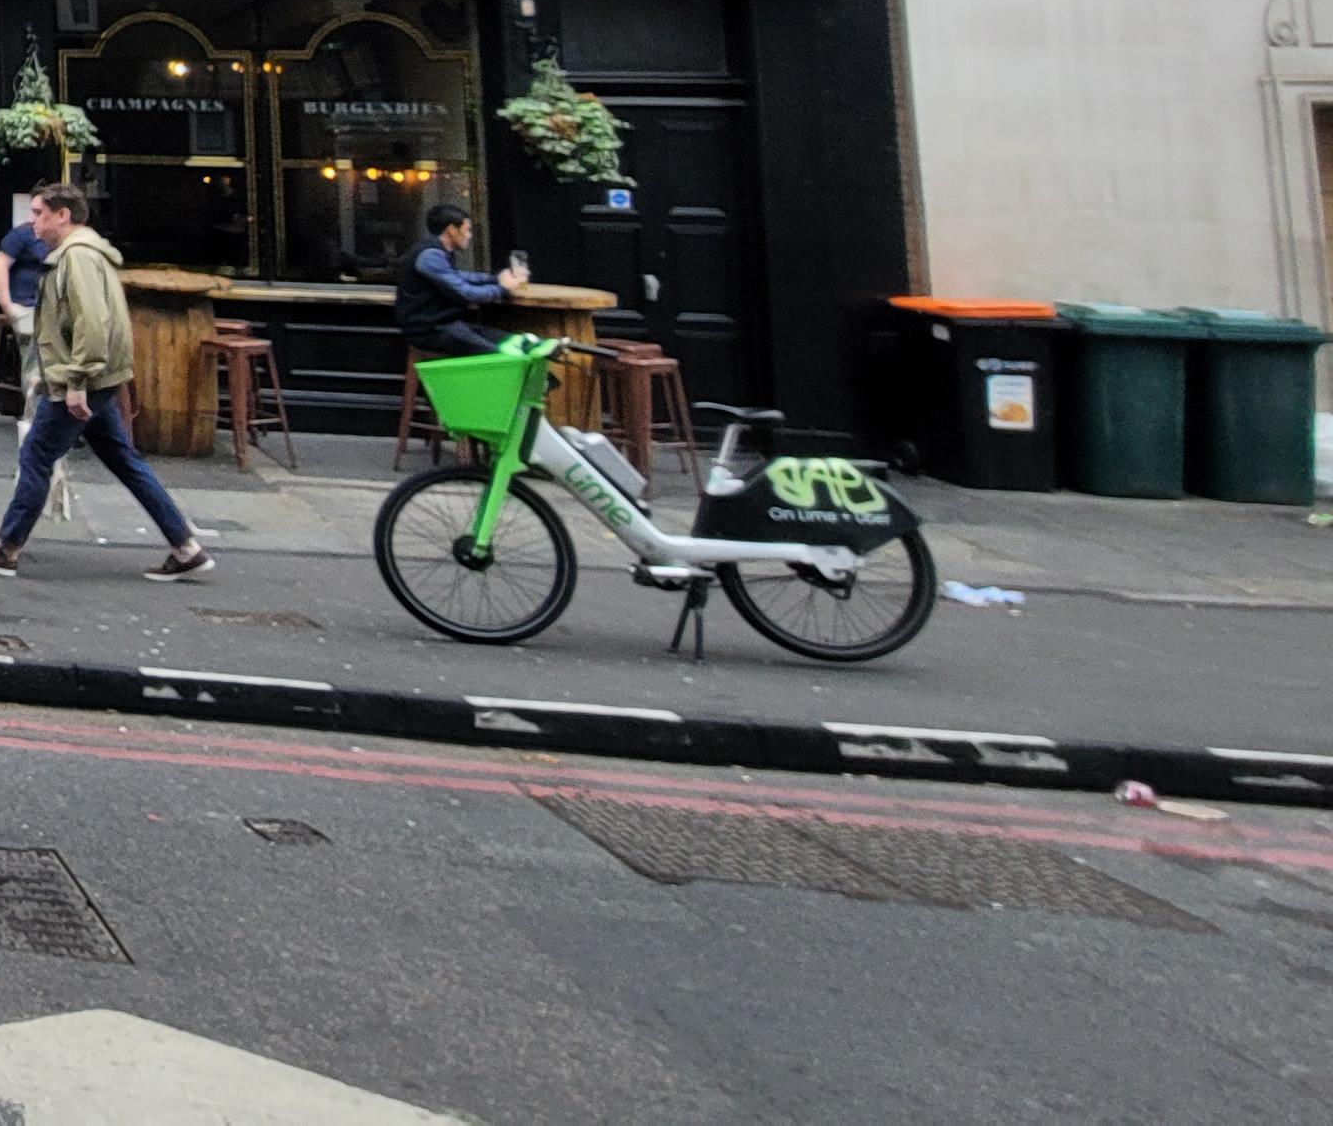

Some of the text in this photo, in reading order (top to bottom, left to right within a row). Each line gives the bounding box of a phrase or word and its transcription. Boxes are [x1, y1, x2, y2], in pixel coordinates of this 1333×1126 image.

[85, 97, 226, 113] CHAMPAGNES
[564, 462, 634, 527] Lime
[768, 506, 796, 521] On
